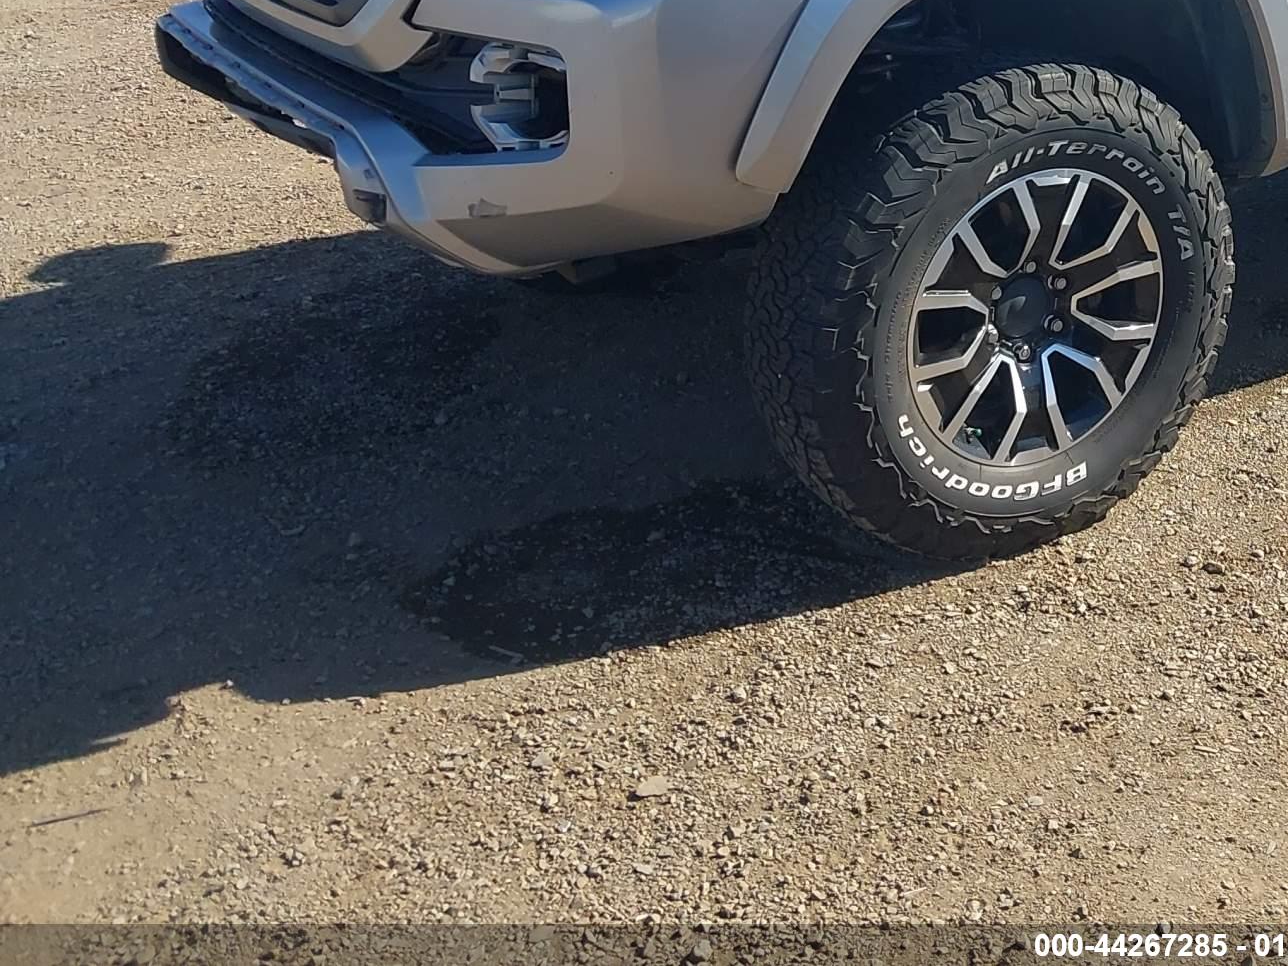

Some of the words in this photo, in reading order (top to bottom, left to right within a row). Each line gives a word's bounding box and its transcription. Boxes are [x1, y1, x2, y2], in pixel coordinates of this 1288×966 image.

[986, 139, 1166, 195] All-Terrain
[1167, 203, 1195, 261] T/A
[898, 414, 1088, 501] BFGoodrich
